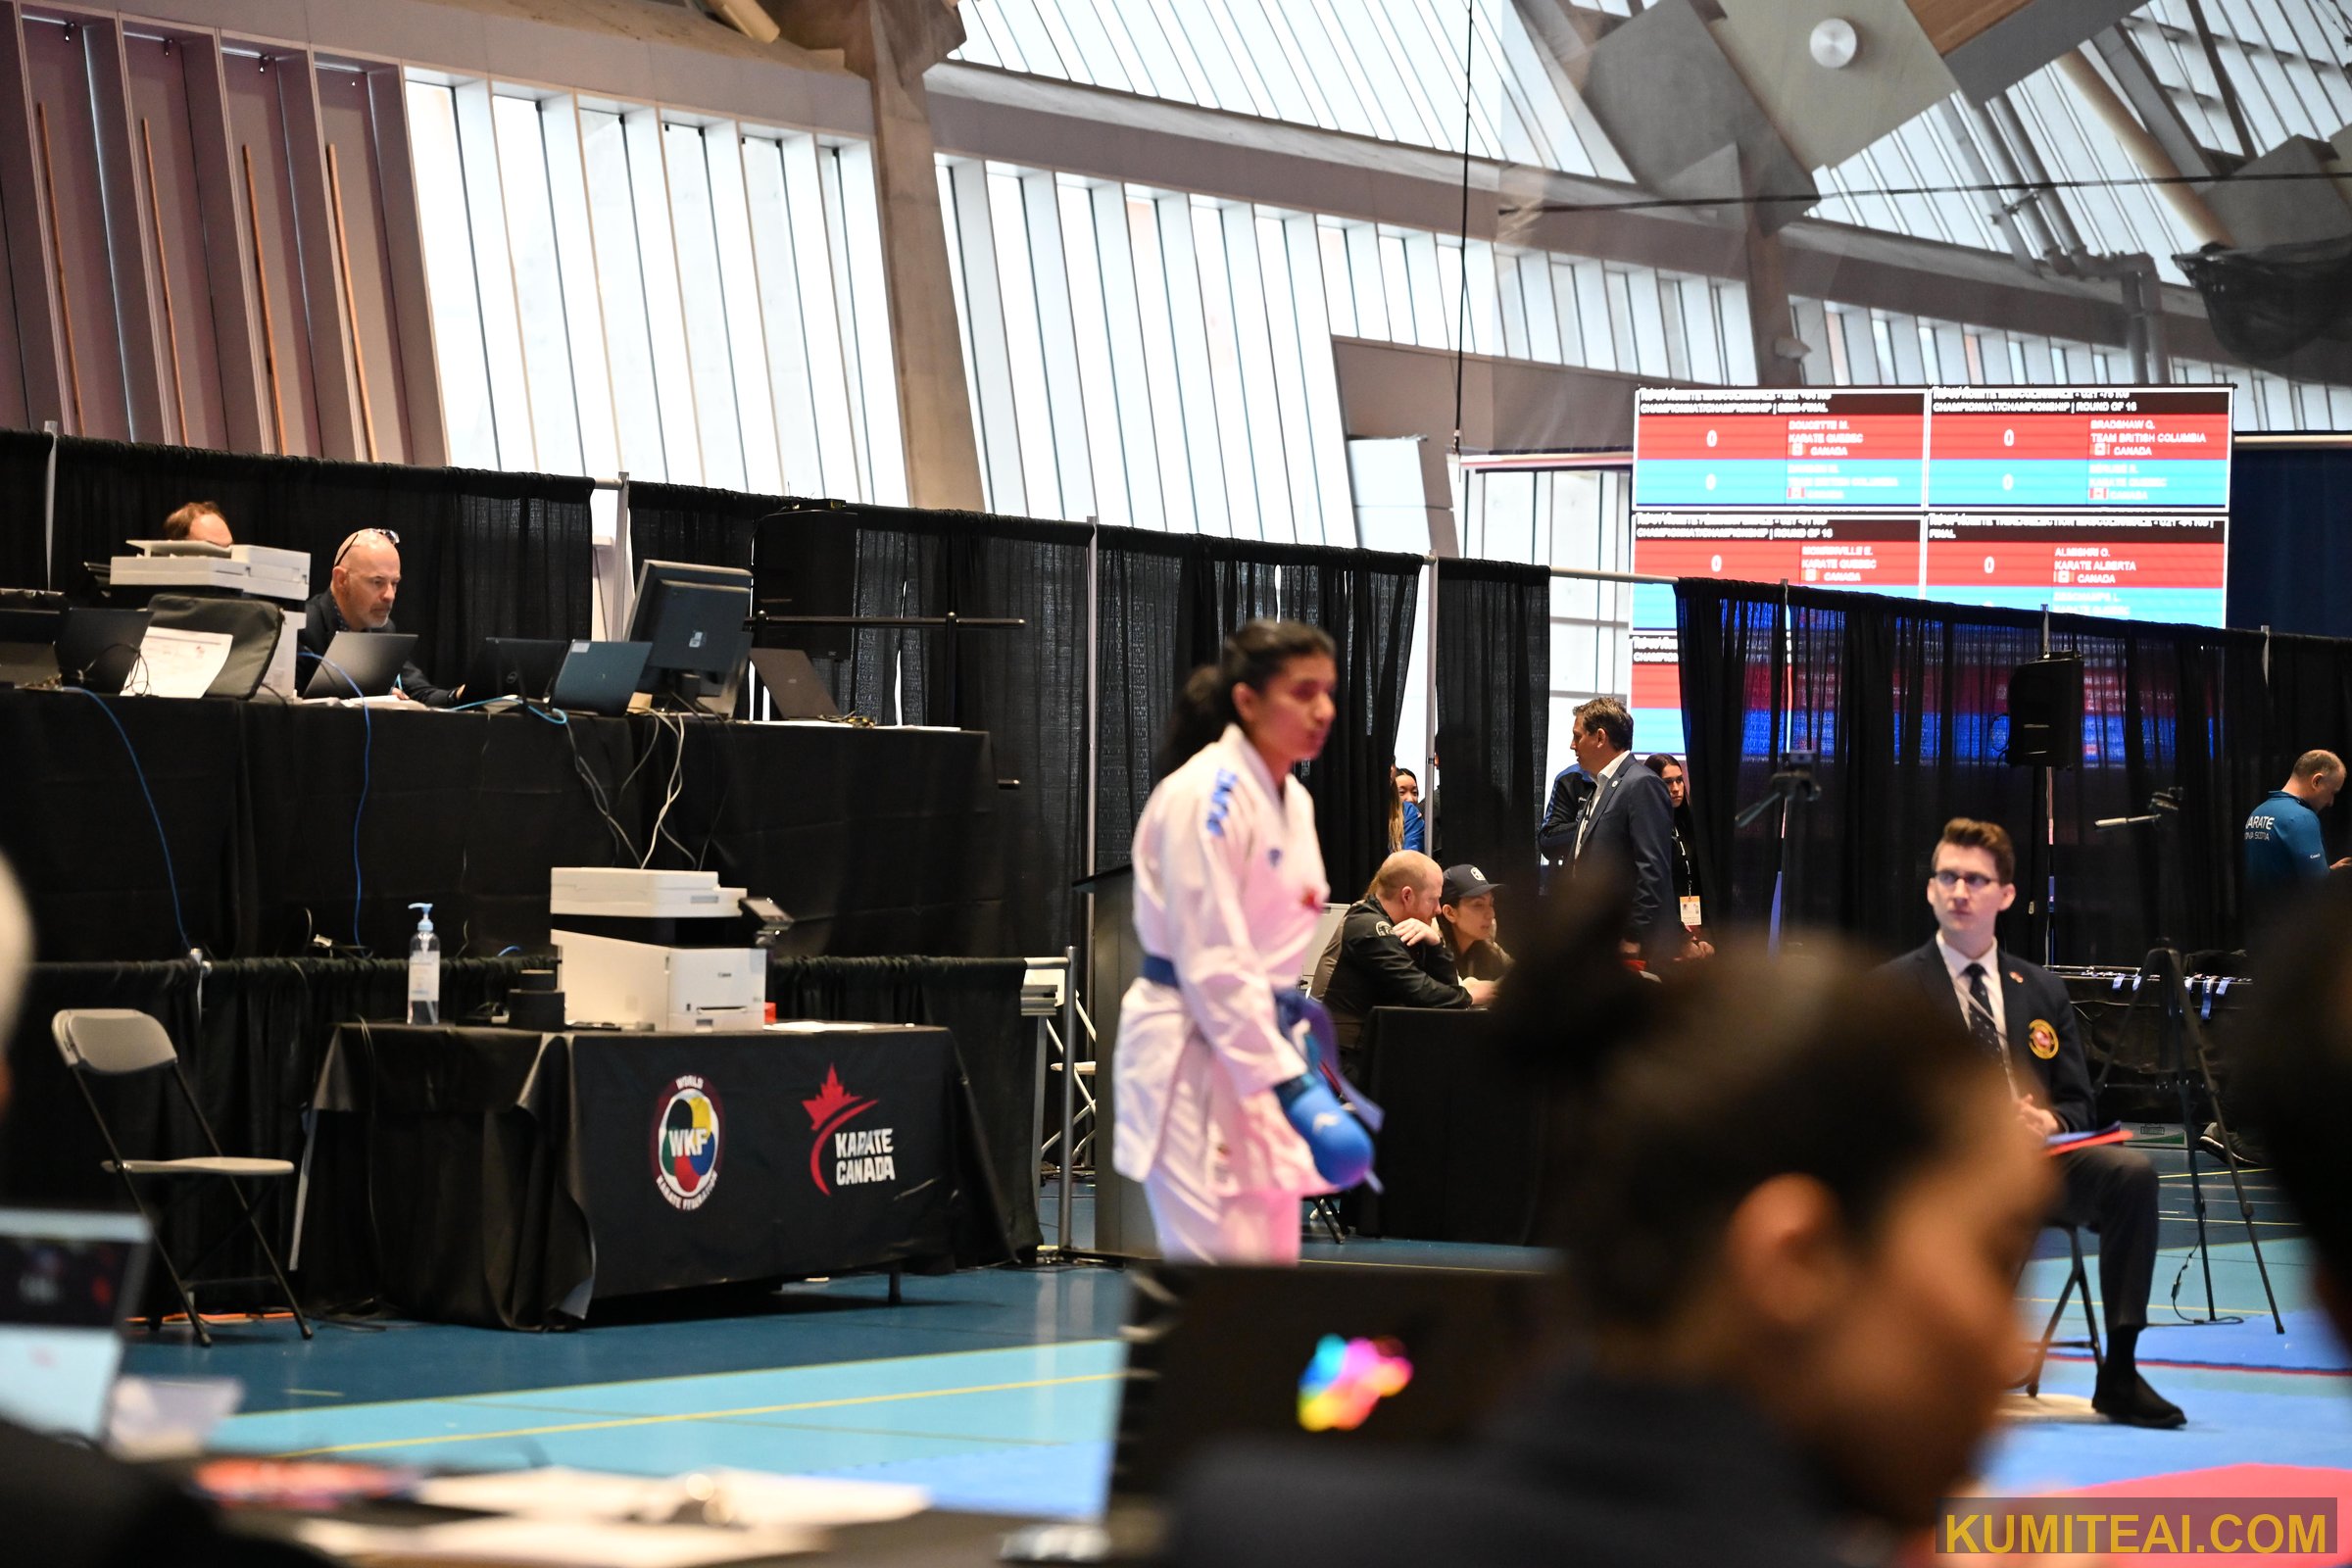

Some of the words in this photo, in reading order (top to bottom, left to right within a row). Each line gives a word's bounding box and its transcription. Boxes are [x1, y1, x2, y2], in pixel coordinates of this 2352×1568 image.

[675, 1074, 704, 1090] WORLD
[668, 1128, 709, 1157] WKF
[835, 1128, 894, 1158] KARATE
[836, 1155, 896, 1186] CANADA
[656, 1174, 682, 1209] KARATE
